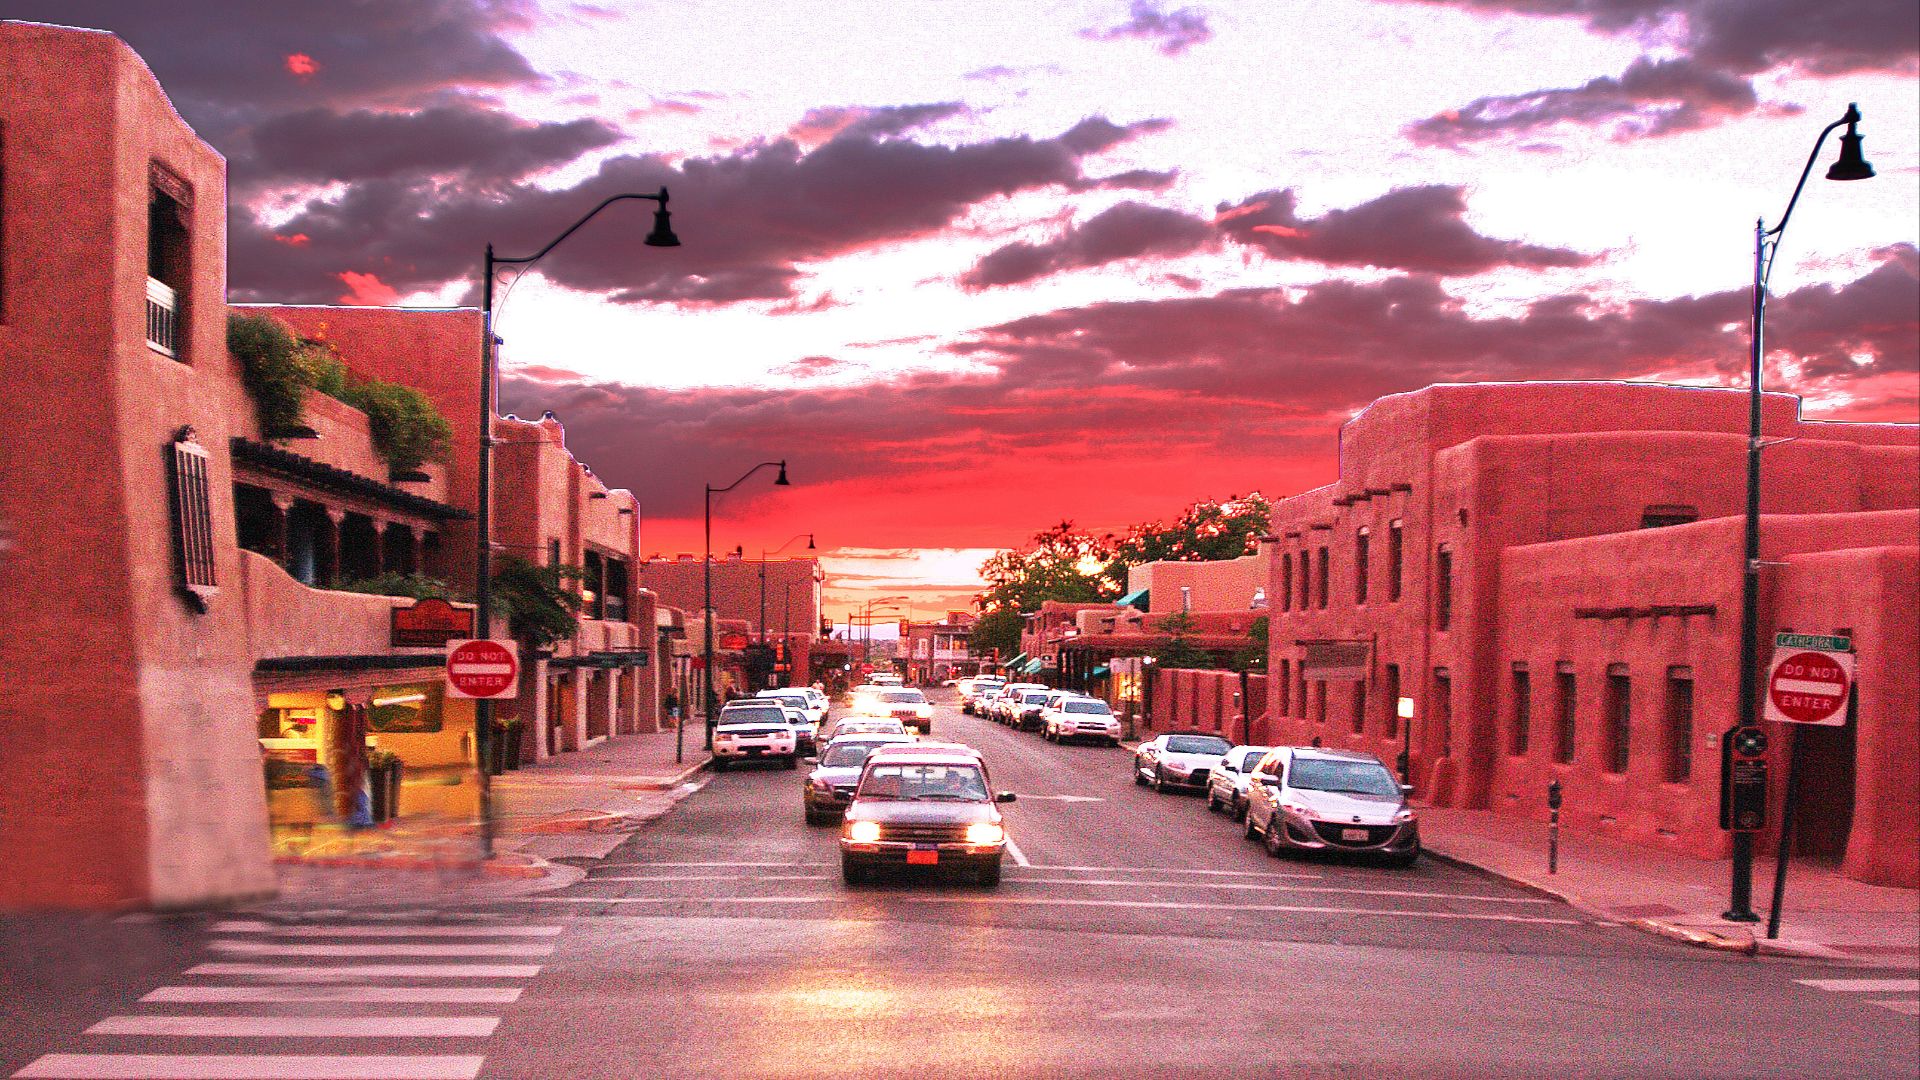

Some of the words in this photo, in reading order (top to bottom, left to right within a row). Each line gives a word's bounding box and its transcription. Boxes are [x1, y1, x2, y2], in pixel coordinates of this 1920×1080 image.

[1780, 635, 1833, 649] CATHEDRAL
[457, 652, 473, 661] DO
[480, 652, 505, 661] NOT
[1785, 664, 1804, 675] DO
[1811, 667, 1839, 678] NOT
[460, 677, 502, 686] ENTER
[1782, 695, 1832, 709] ENTER
